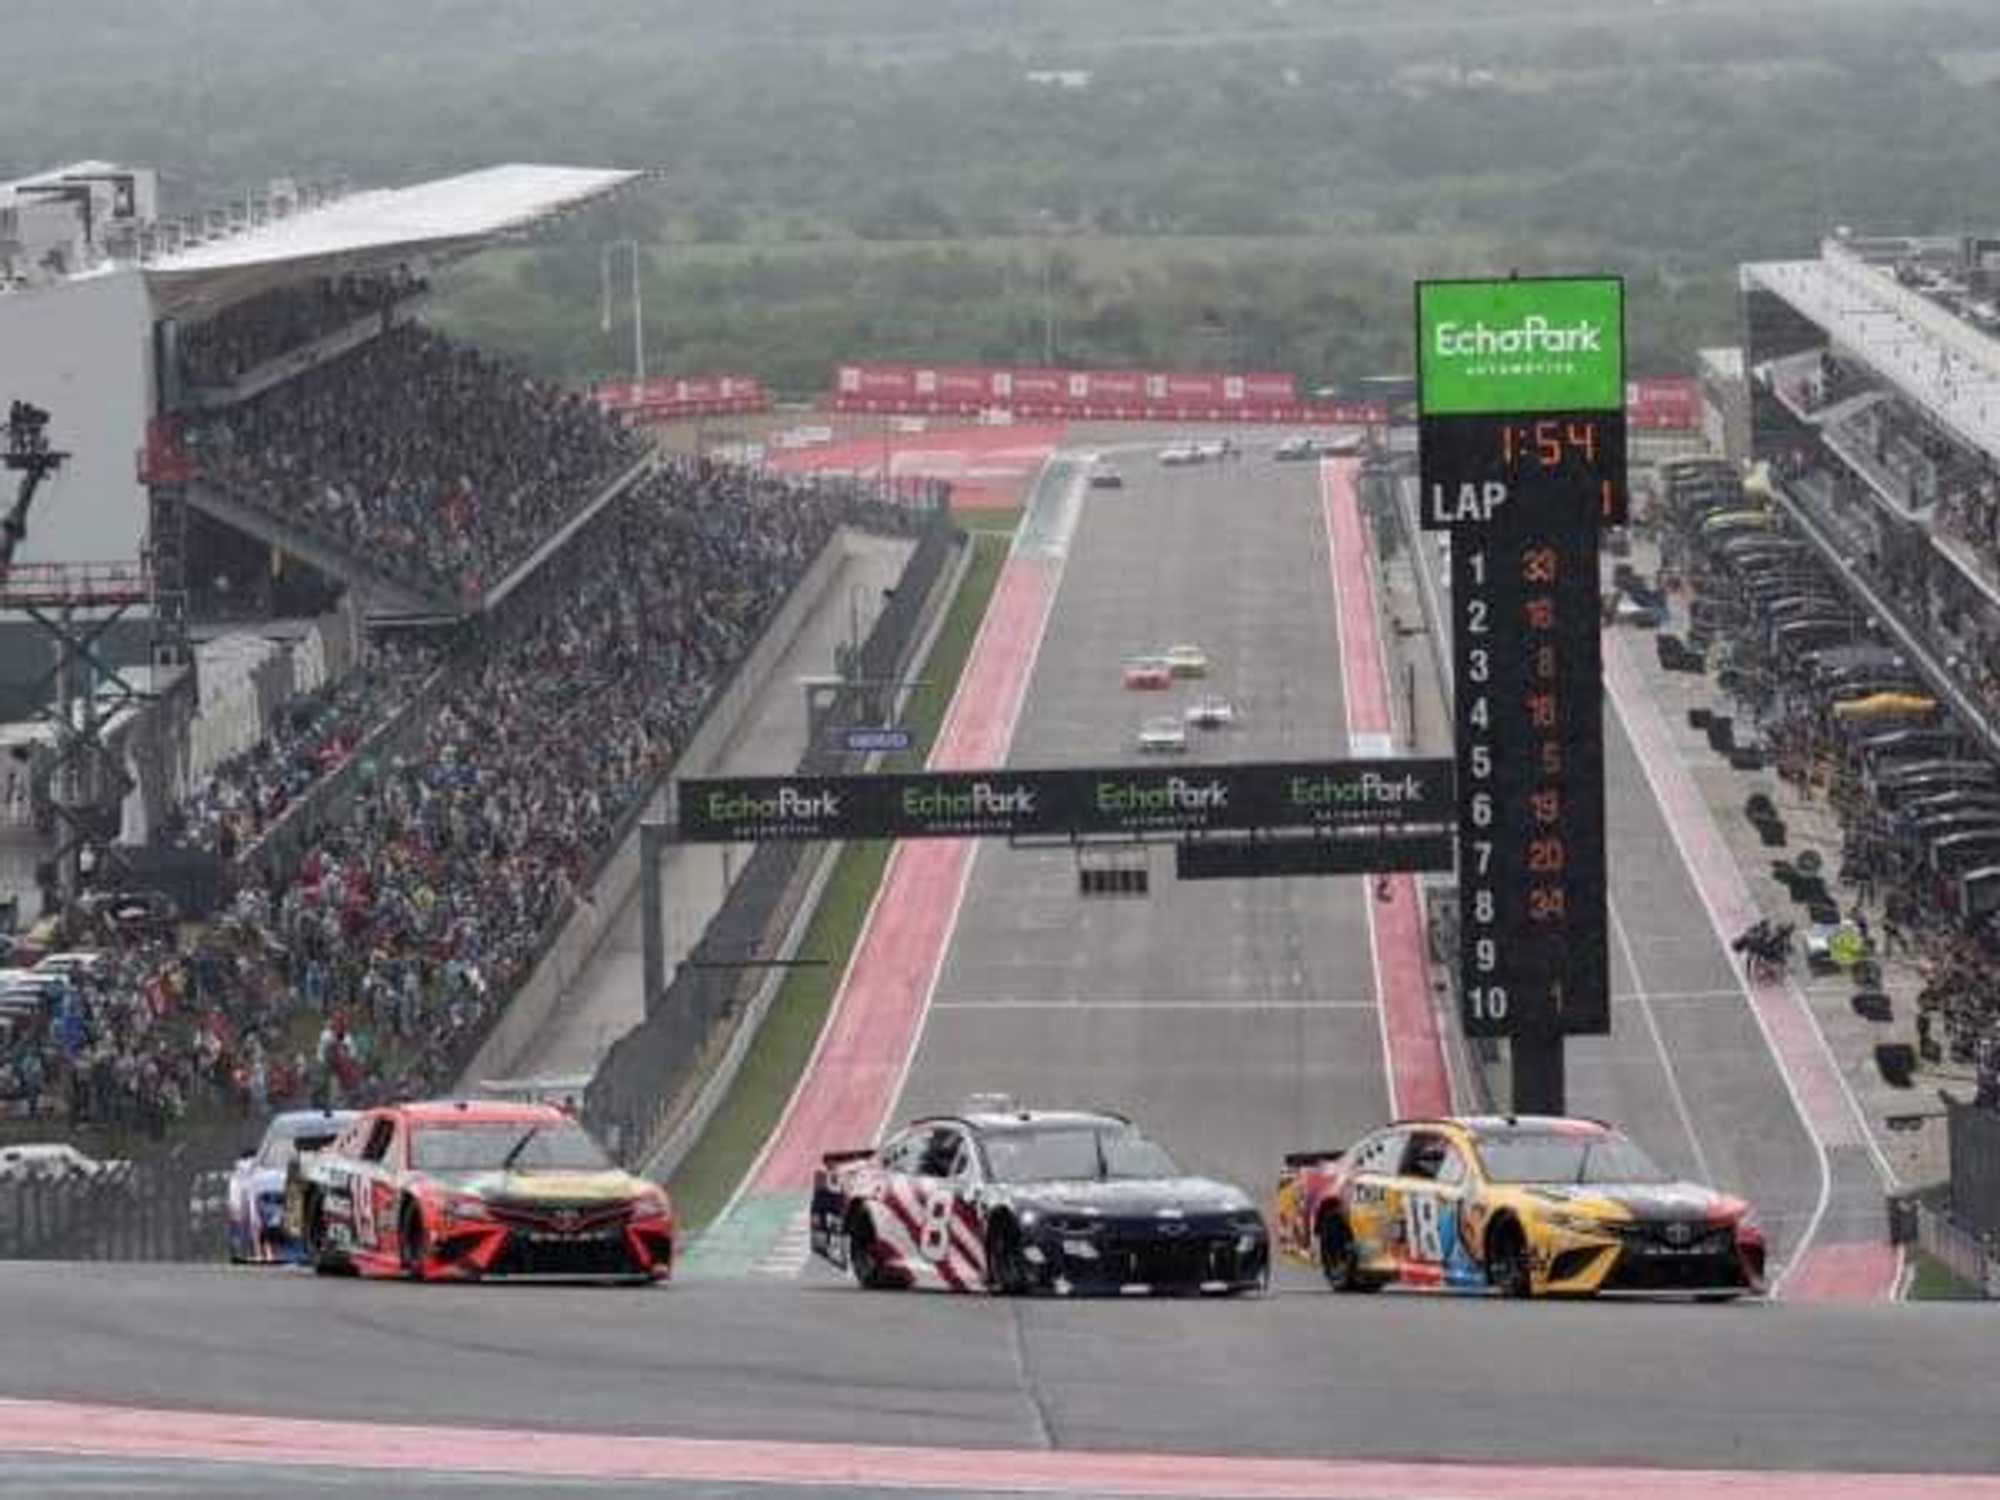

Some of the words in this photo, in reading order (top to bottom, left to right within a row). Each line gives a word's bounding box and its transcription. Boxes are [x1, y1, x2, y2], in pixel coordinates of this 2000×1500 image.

[1437, 316, 1601, 355] EchoPark
[1503, 422, 1594, 465] 1:54
[1433, 481, 1507, 522] LAP
[1469, 552, 1485, 584] 1
[1467, 601, 1489, 633] 2
[1469, 650, 1489, 682] 3
[1469, 697, 1488, 730] 4
[1472, 747, 1491, 778] 5
[904, 783, 1037, 815] EchoPark
[1097, 777, 1229, 809] EchoPark
[1291, 772, 1425, 804] EchoPark
[709, 787, 842, 822] EchoPark
[1472, 793, 1492, 826] 6
[1474, 842, 1492, 874] 7
[1475, 890, 1494, 922] 8
[1476, 939, 1495, 971] 9
[1467, 987, 1507, 1018] 10
[919, 1190, 952, 1261] 8
[1405, 1191, 1442, 1261] 18
